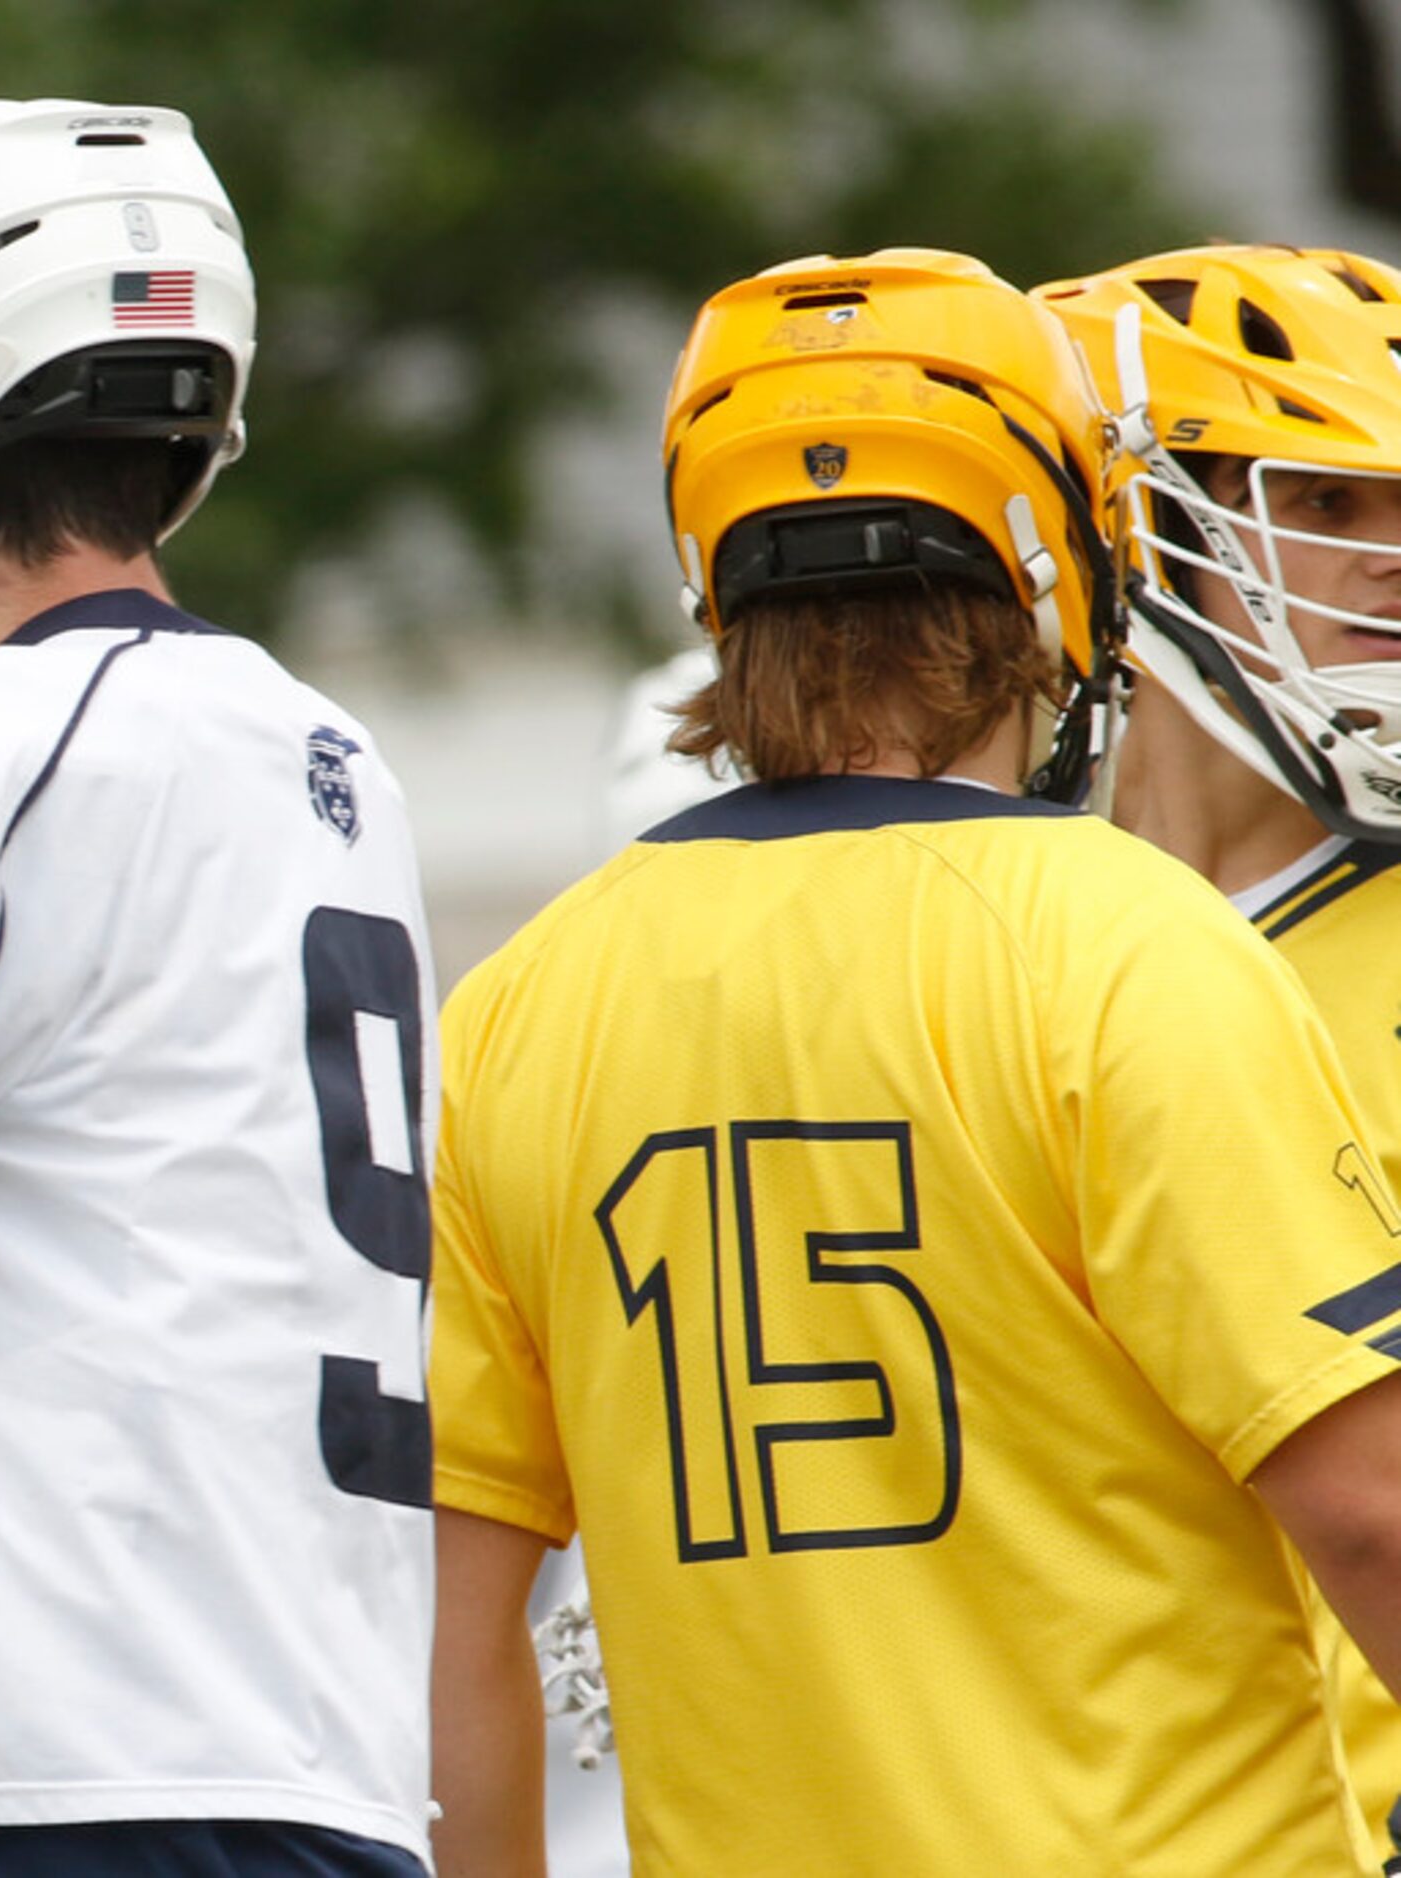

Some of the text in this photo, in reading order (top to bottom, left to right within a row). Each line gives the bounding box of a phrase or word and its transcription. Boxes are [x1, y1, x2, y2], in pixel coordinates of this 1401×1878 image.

[122, 201, 161, 253] 9
[303, 906, 435, 1510] 9
[594, 1119, 963, 1564] 15
